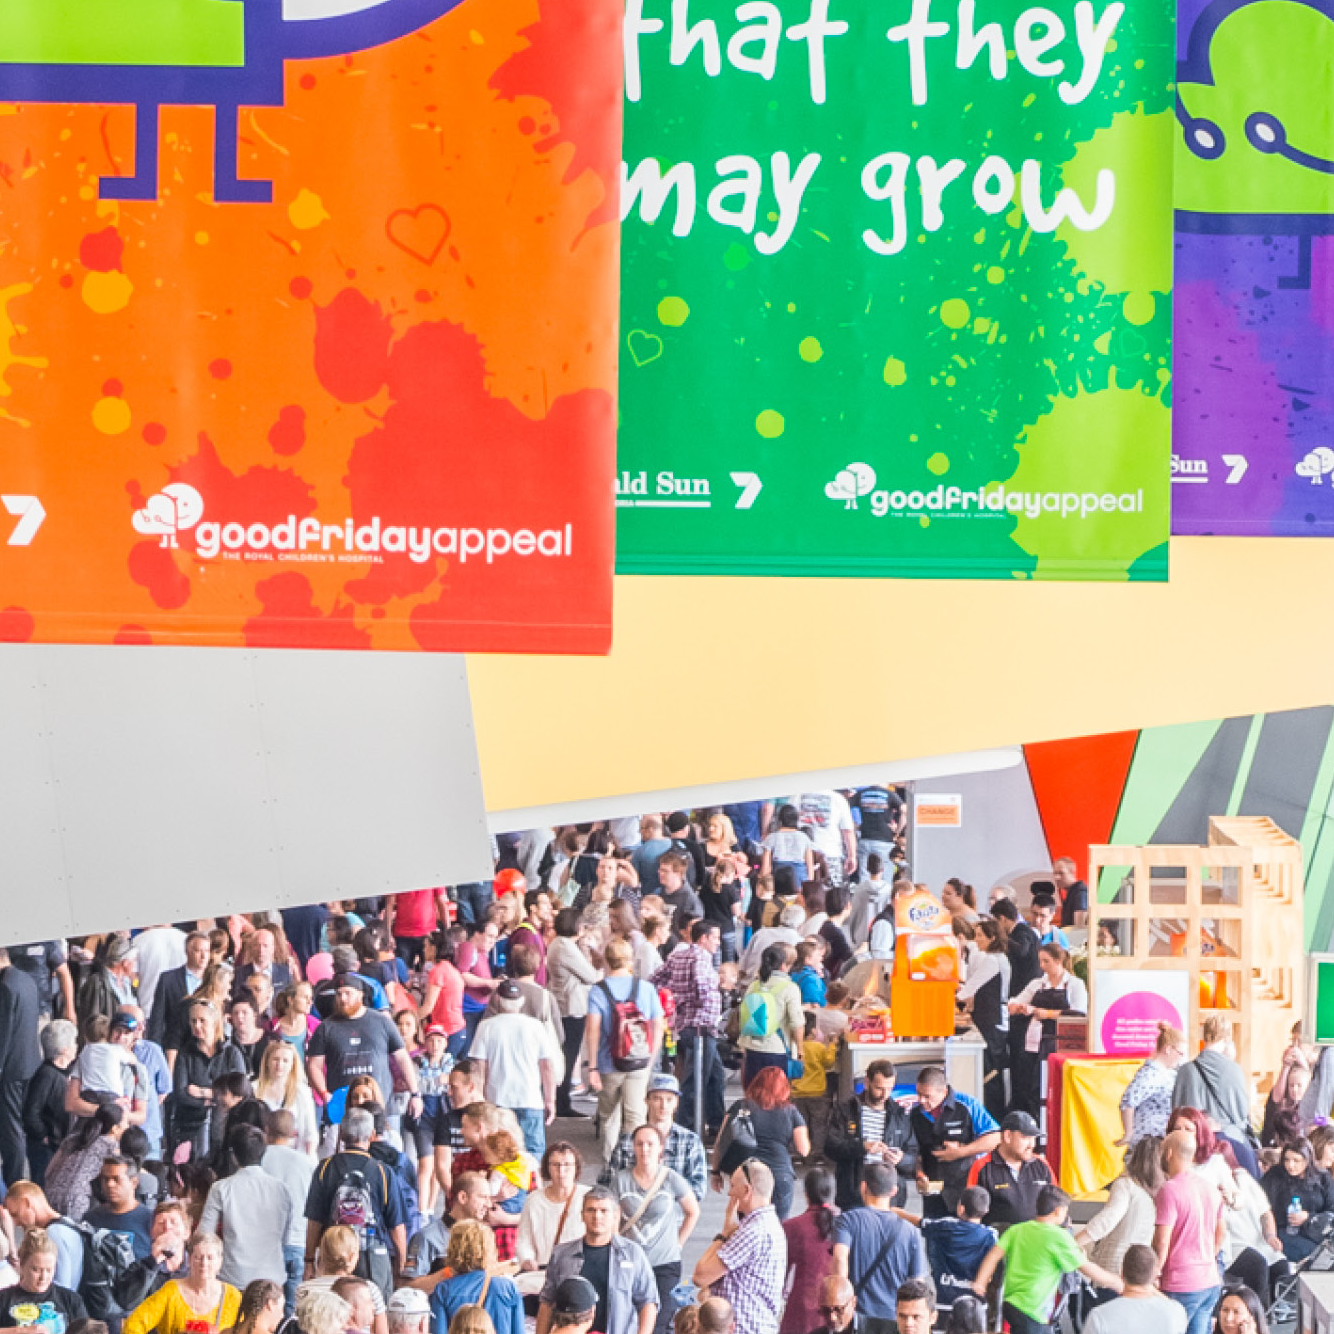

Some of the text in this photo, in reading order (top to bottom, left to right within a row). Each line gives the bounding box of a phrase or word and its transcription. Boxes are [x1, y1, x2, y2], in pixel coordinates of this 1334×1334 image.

[618, 149, 1117, 255] may grow
[655, 471, 712, 496] Sun
[870, 484, 1144, 519] goodfridayappeal
[195, 514, 573, 565] goodfridayappeal
[222, 552, 384, 565] THE ROYAL CHILDREN'S HOSPITAL
